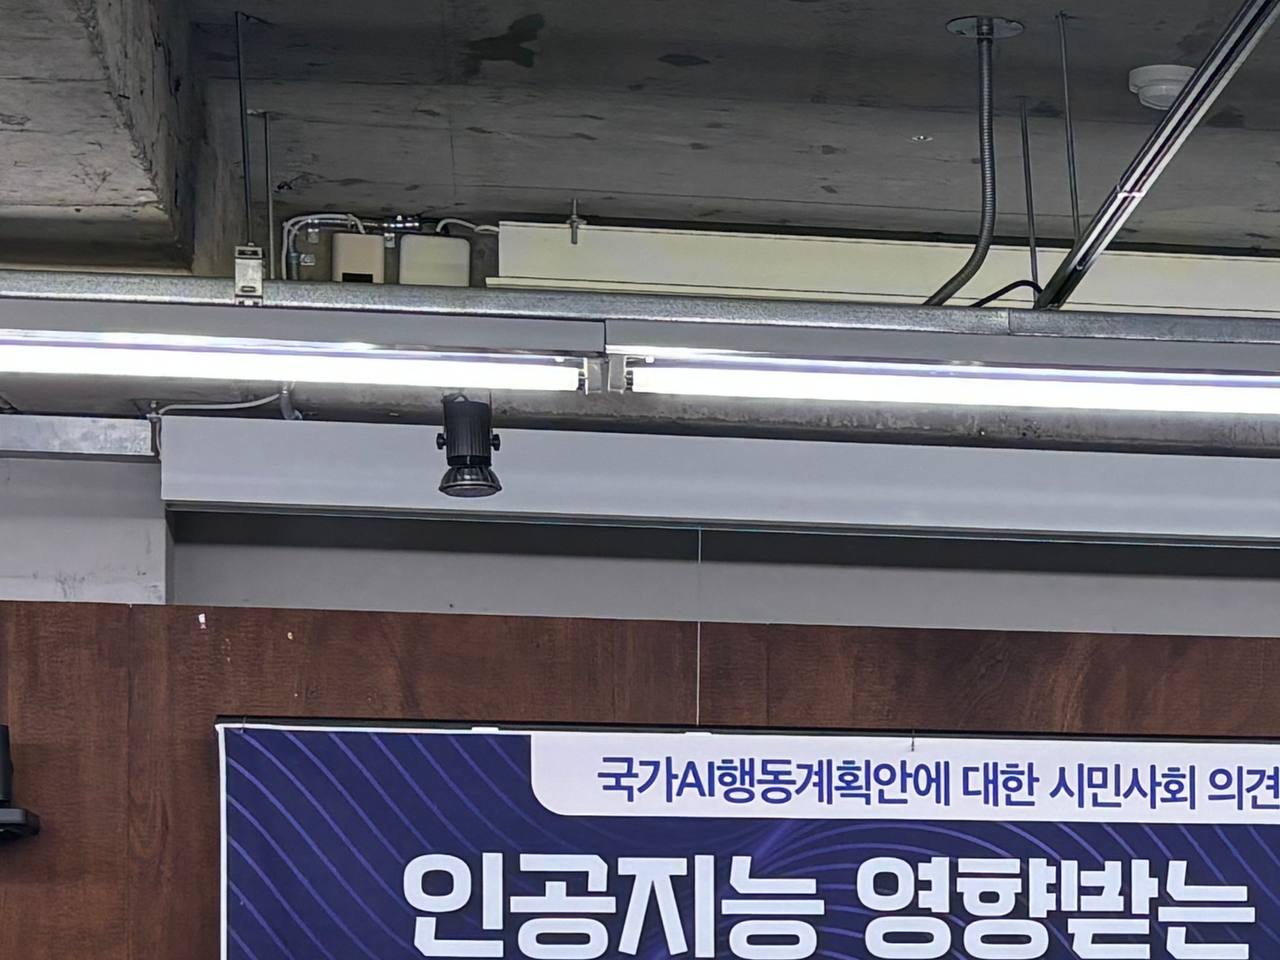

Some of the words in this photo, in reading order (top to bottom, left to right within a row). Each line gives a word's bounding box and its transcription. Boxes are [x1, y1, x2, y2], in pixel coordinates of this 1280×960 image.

[598, 756, 950, 806] 국가AI행동계획안에
[963, 762, 1039, 807] 대한
[1050, 763, 1195, 810] 시민사회
[404, 853, 824, 960] 인공지능
[857, 857, 1255, 960] 영향받는
